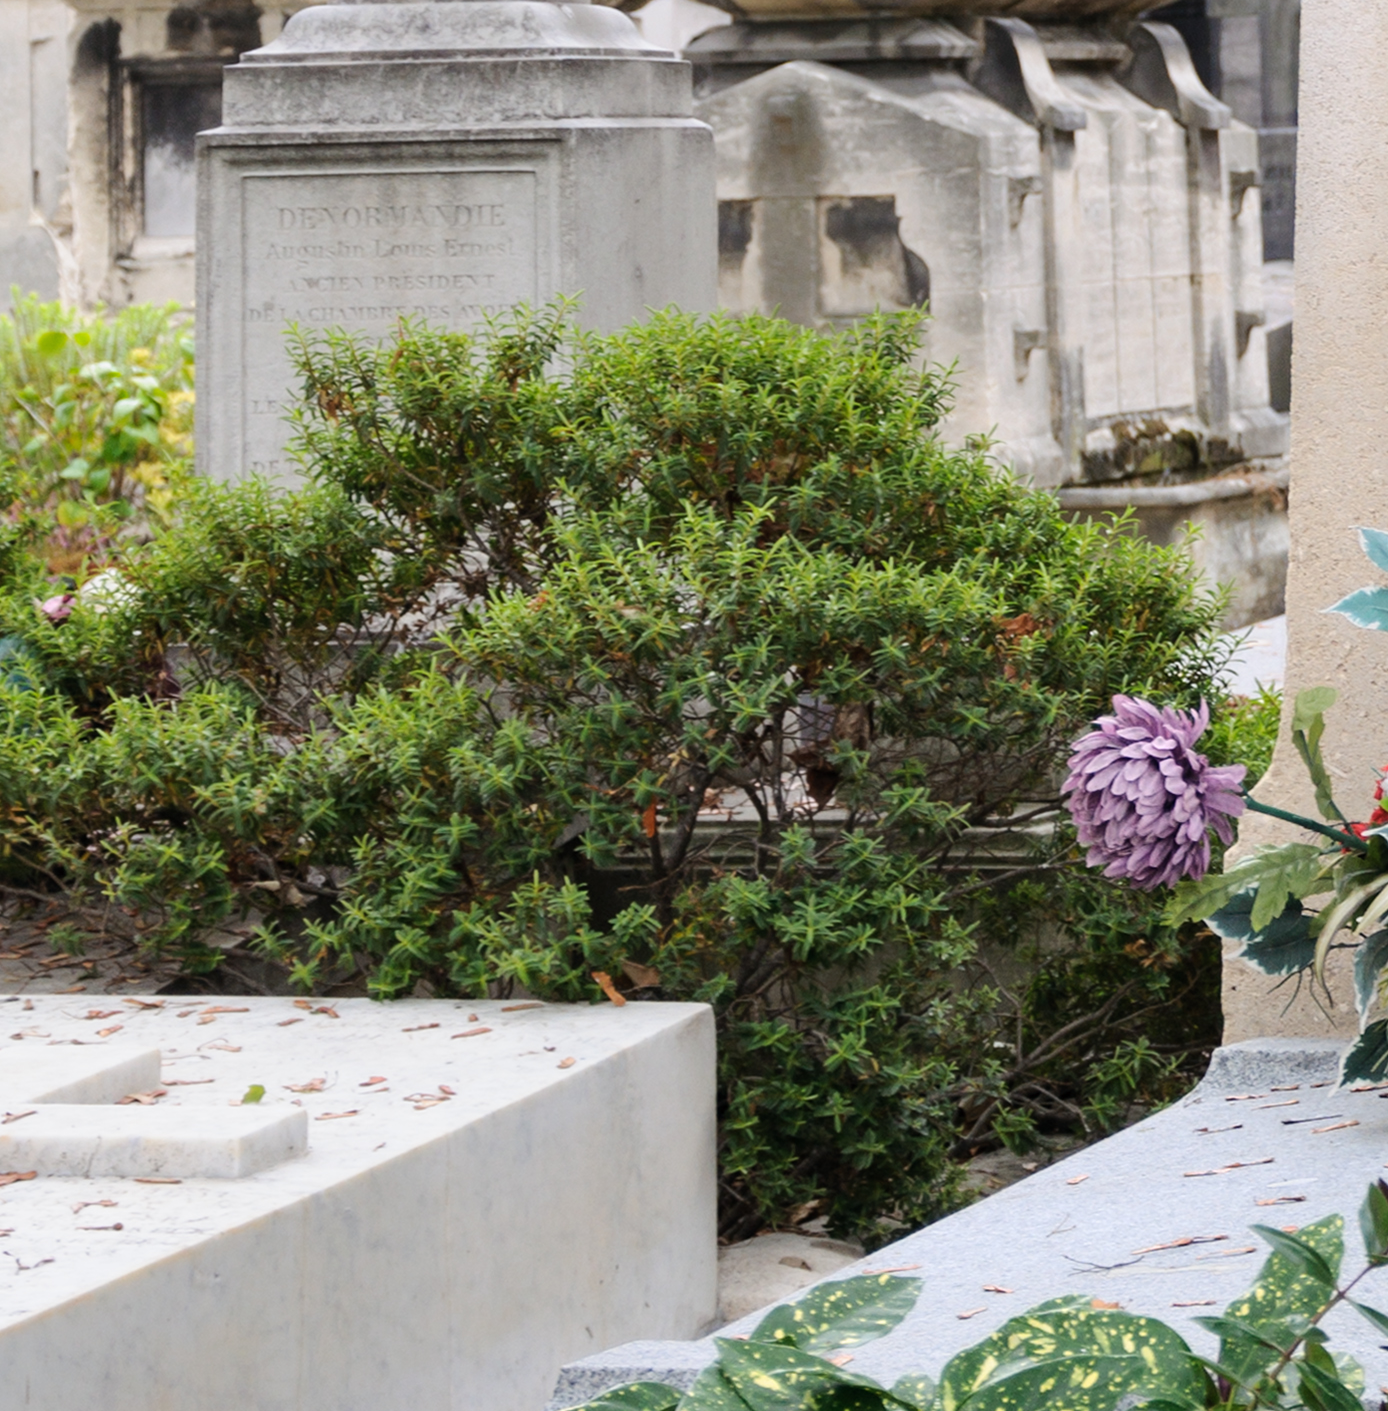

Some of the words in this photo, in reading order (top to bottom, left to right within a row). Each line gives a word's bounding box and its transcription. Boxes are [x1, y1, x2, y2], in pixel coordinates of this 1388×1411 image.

[265, 239, 365, 270] Augustin
[373, 239, 436, 258] Louis
[443, 238, 516, 257] Ernest
